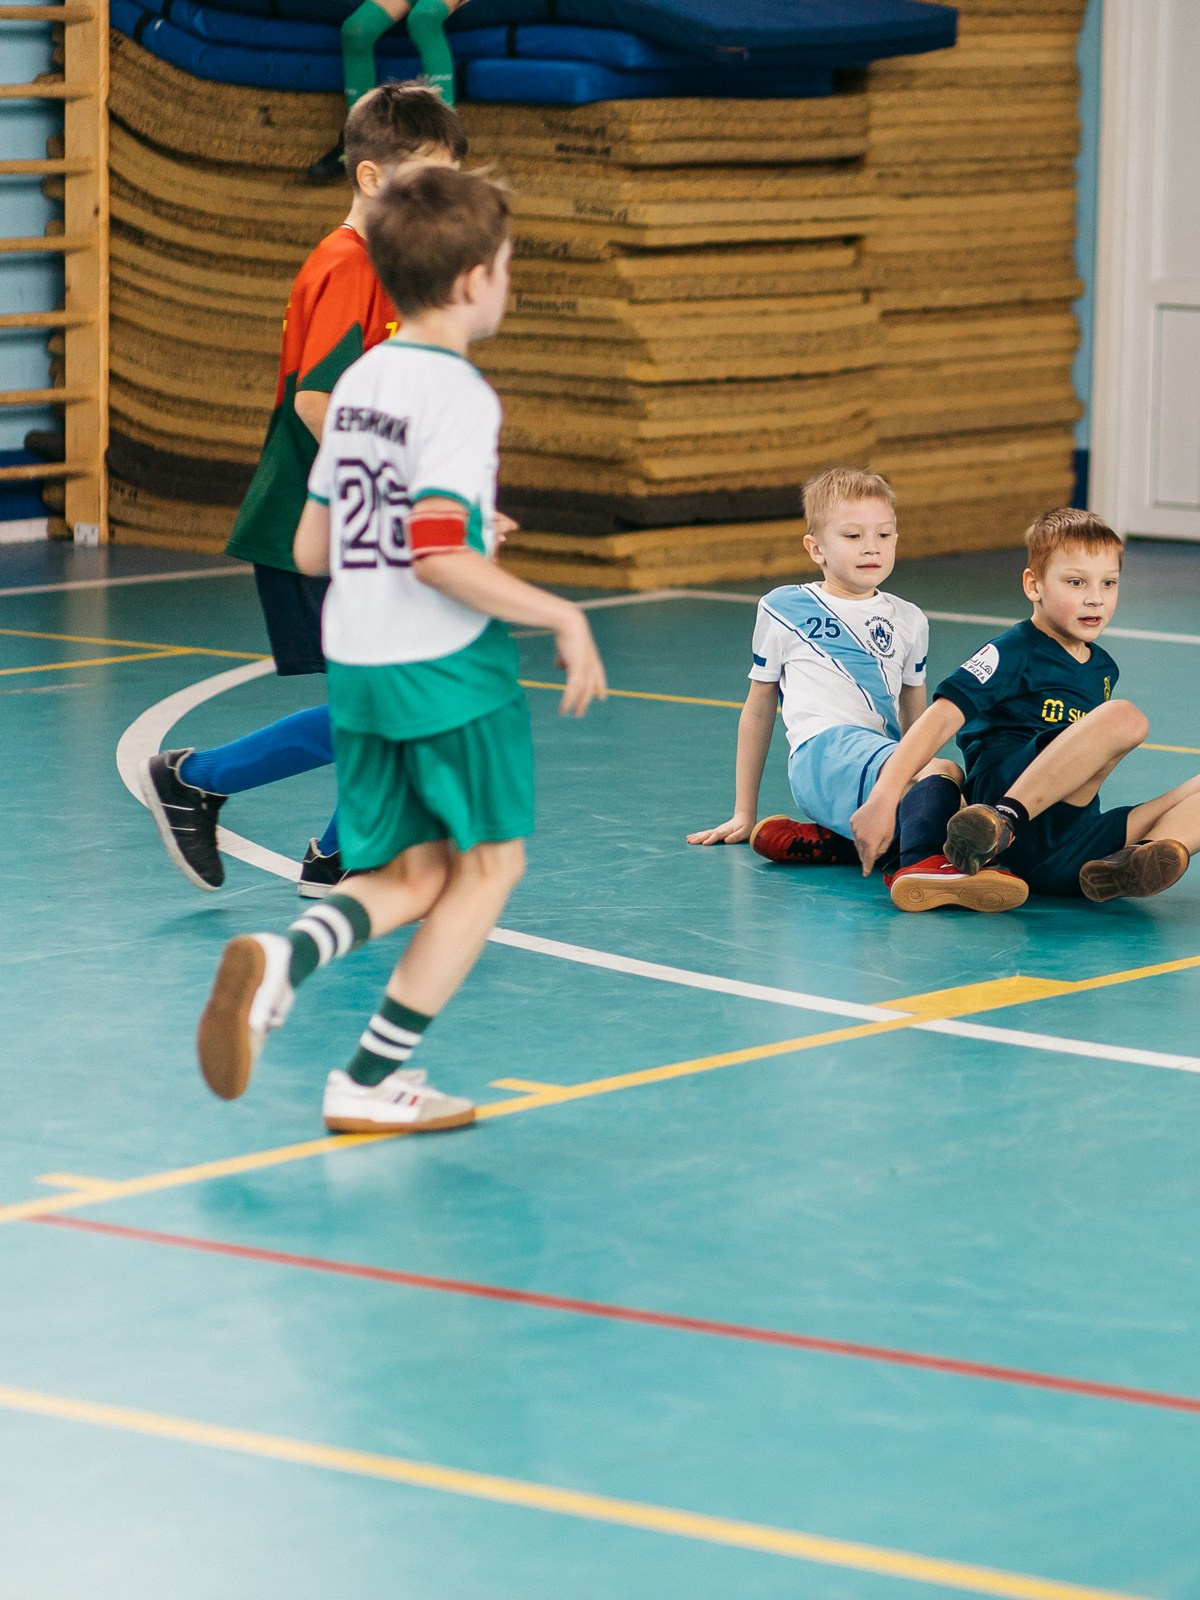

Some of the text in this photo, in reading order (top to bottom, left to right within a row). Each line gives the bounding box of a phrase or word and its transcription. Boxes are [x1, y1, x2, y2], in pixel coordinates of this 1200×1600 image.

[337, 459, 412, 568] 26
[806, 617, 841, 639] 25
[968, 664, 985, 681] PIZZA
